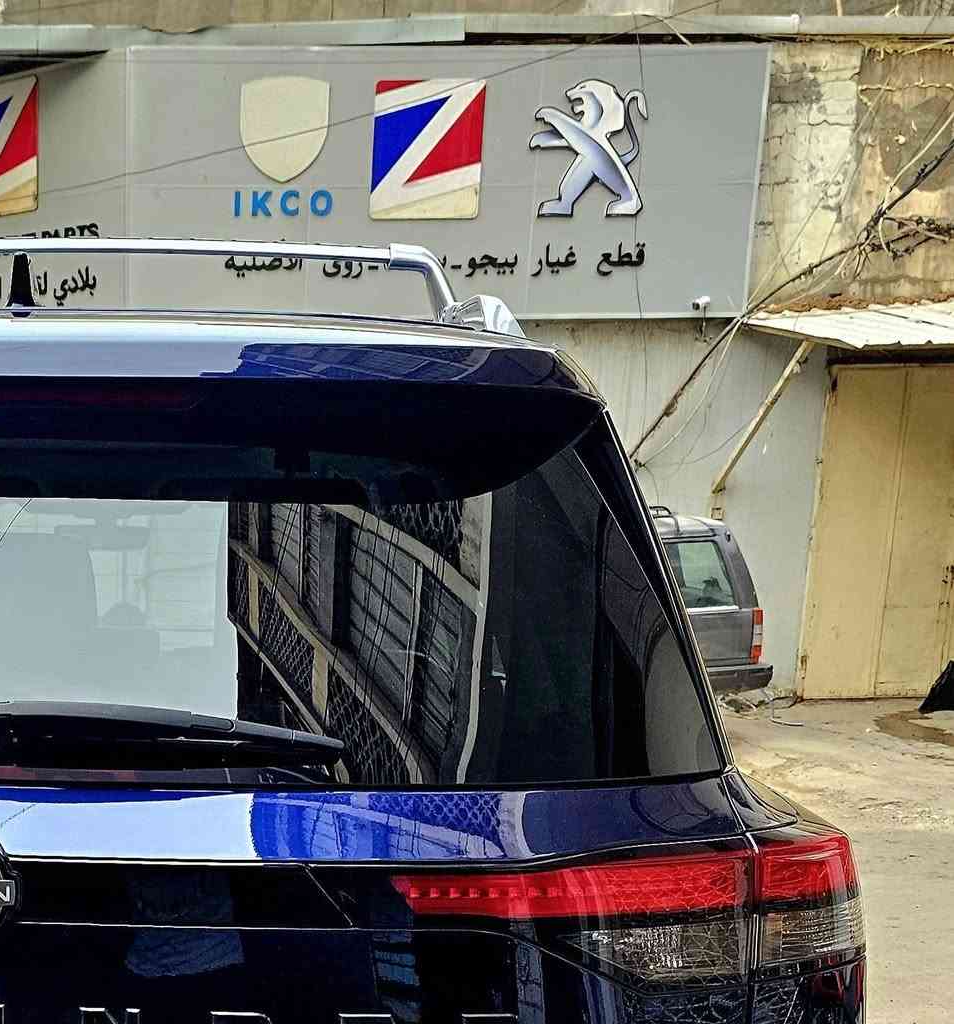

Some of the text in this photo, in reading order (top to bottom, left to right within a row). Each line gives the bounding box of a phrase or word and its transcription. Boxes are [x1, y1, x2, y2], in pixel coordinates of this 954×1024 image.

[233, 190, 334, 217] IKCO
[531, 243, 578, 277] غيار
[596, 241, 646, 277] قطع
[53, 266, 97, 306] بلادي
